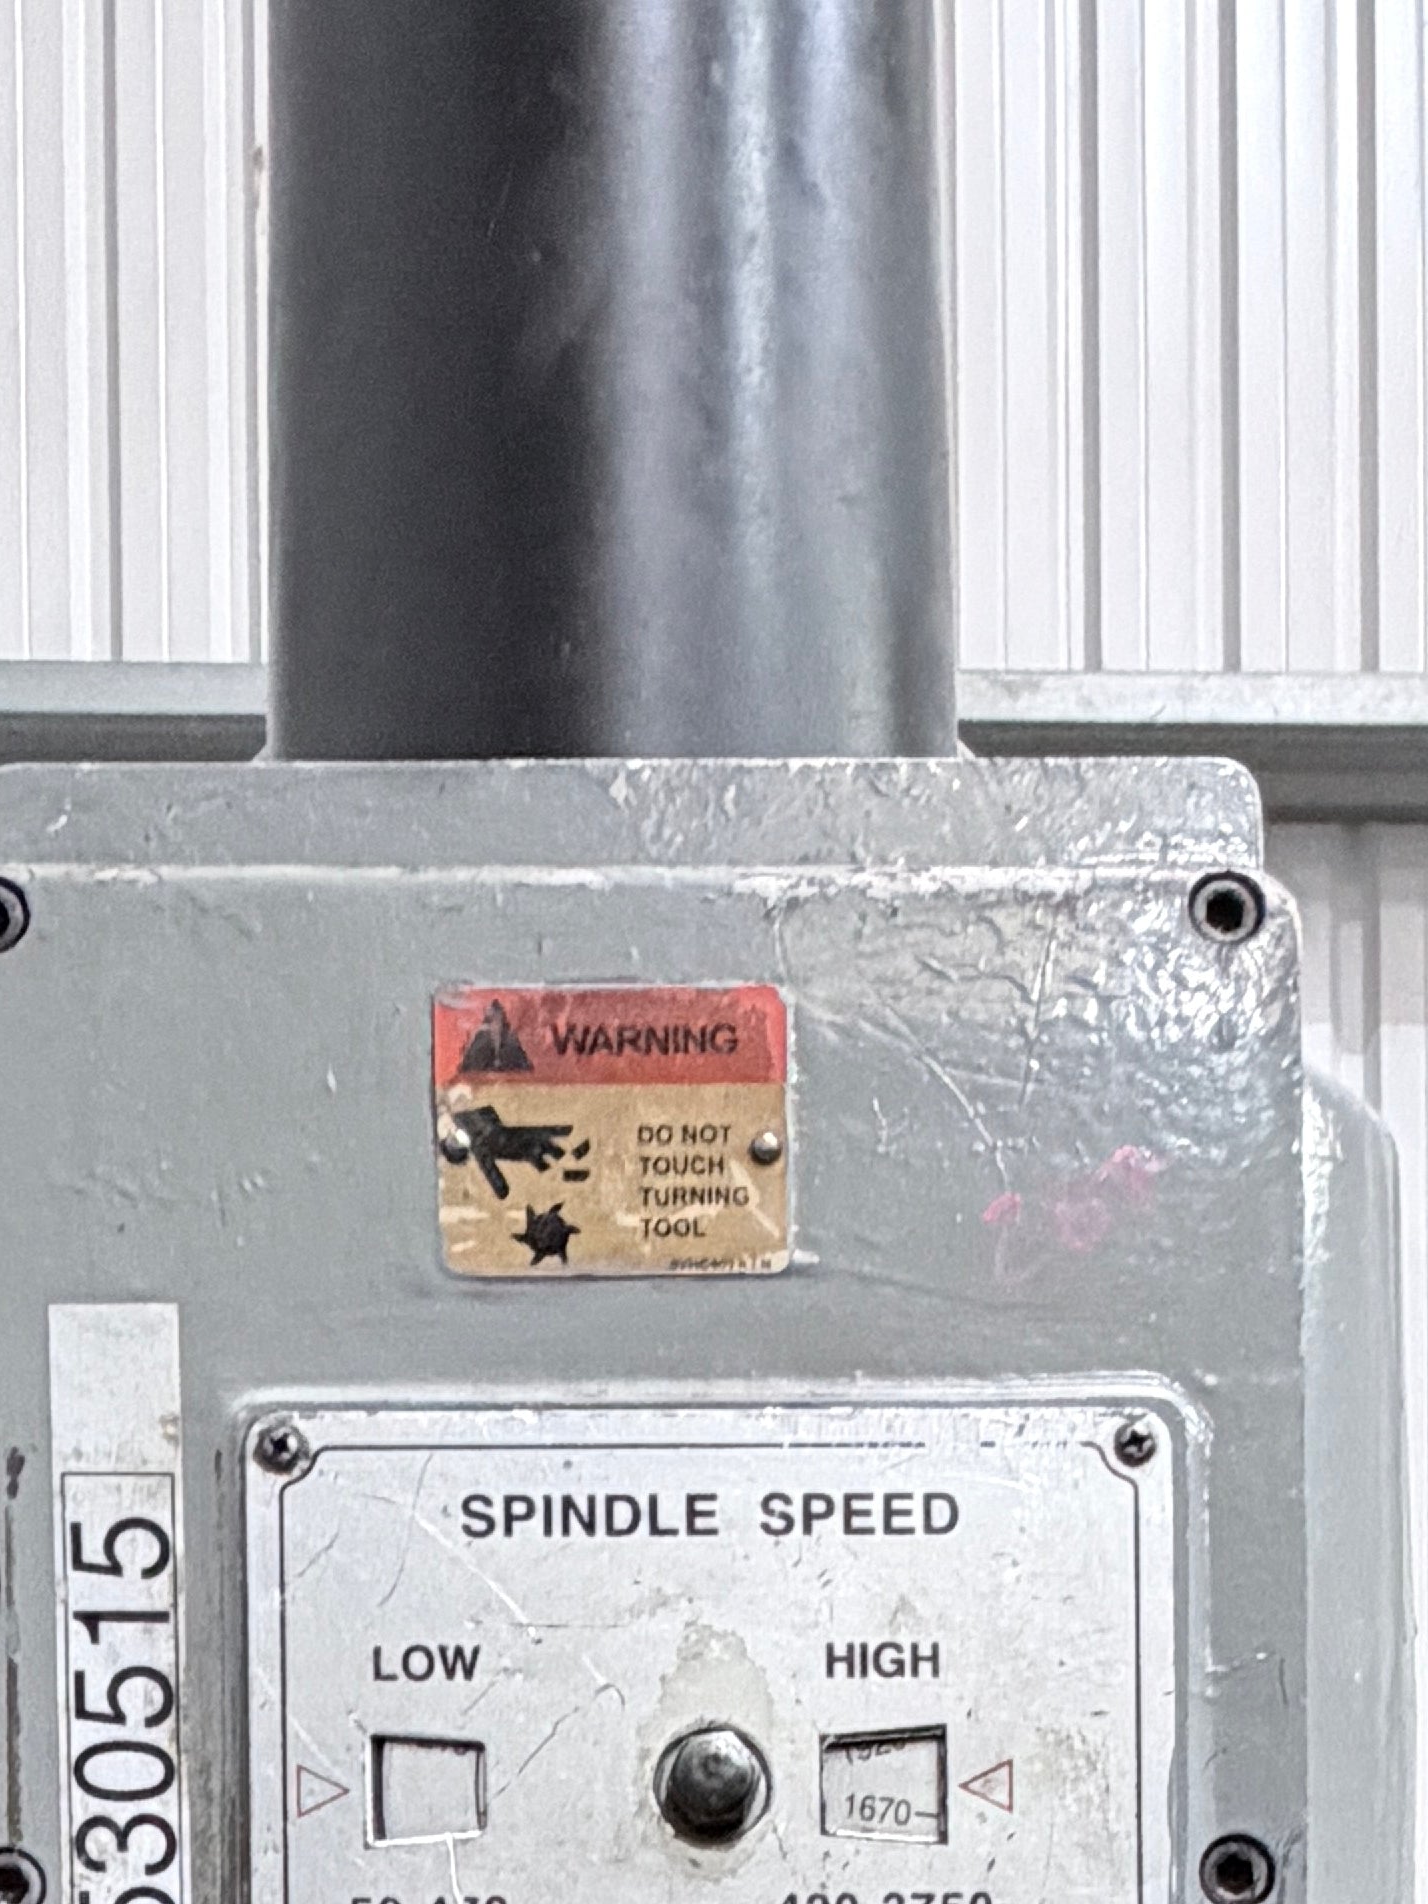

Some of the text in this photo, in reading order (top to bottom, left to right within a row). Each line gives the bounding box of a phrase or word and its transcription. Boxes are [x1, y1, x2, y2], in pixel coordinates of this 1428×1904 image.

[551, 1022, 739, 1056] WARNING
[637, 1124, 731, 1146] DO NOT
[638, 1155, 725, 1176] TOUCH
[639, 1185, 750, 1207] TURNING
[640, 1217, 707, 1238] TOOL
[460, 1491, 962, 1539] SPINDLE SPEED
[372, 1645, 482, 1682] LOW
[825, 1642, 942, 1680] HIGH
[845, 1793, 912, 1827] 1670
